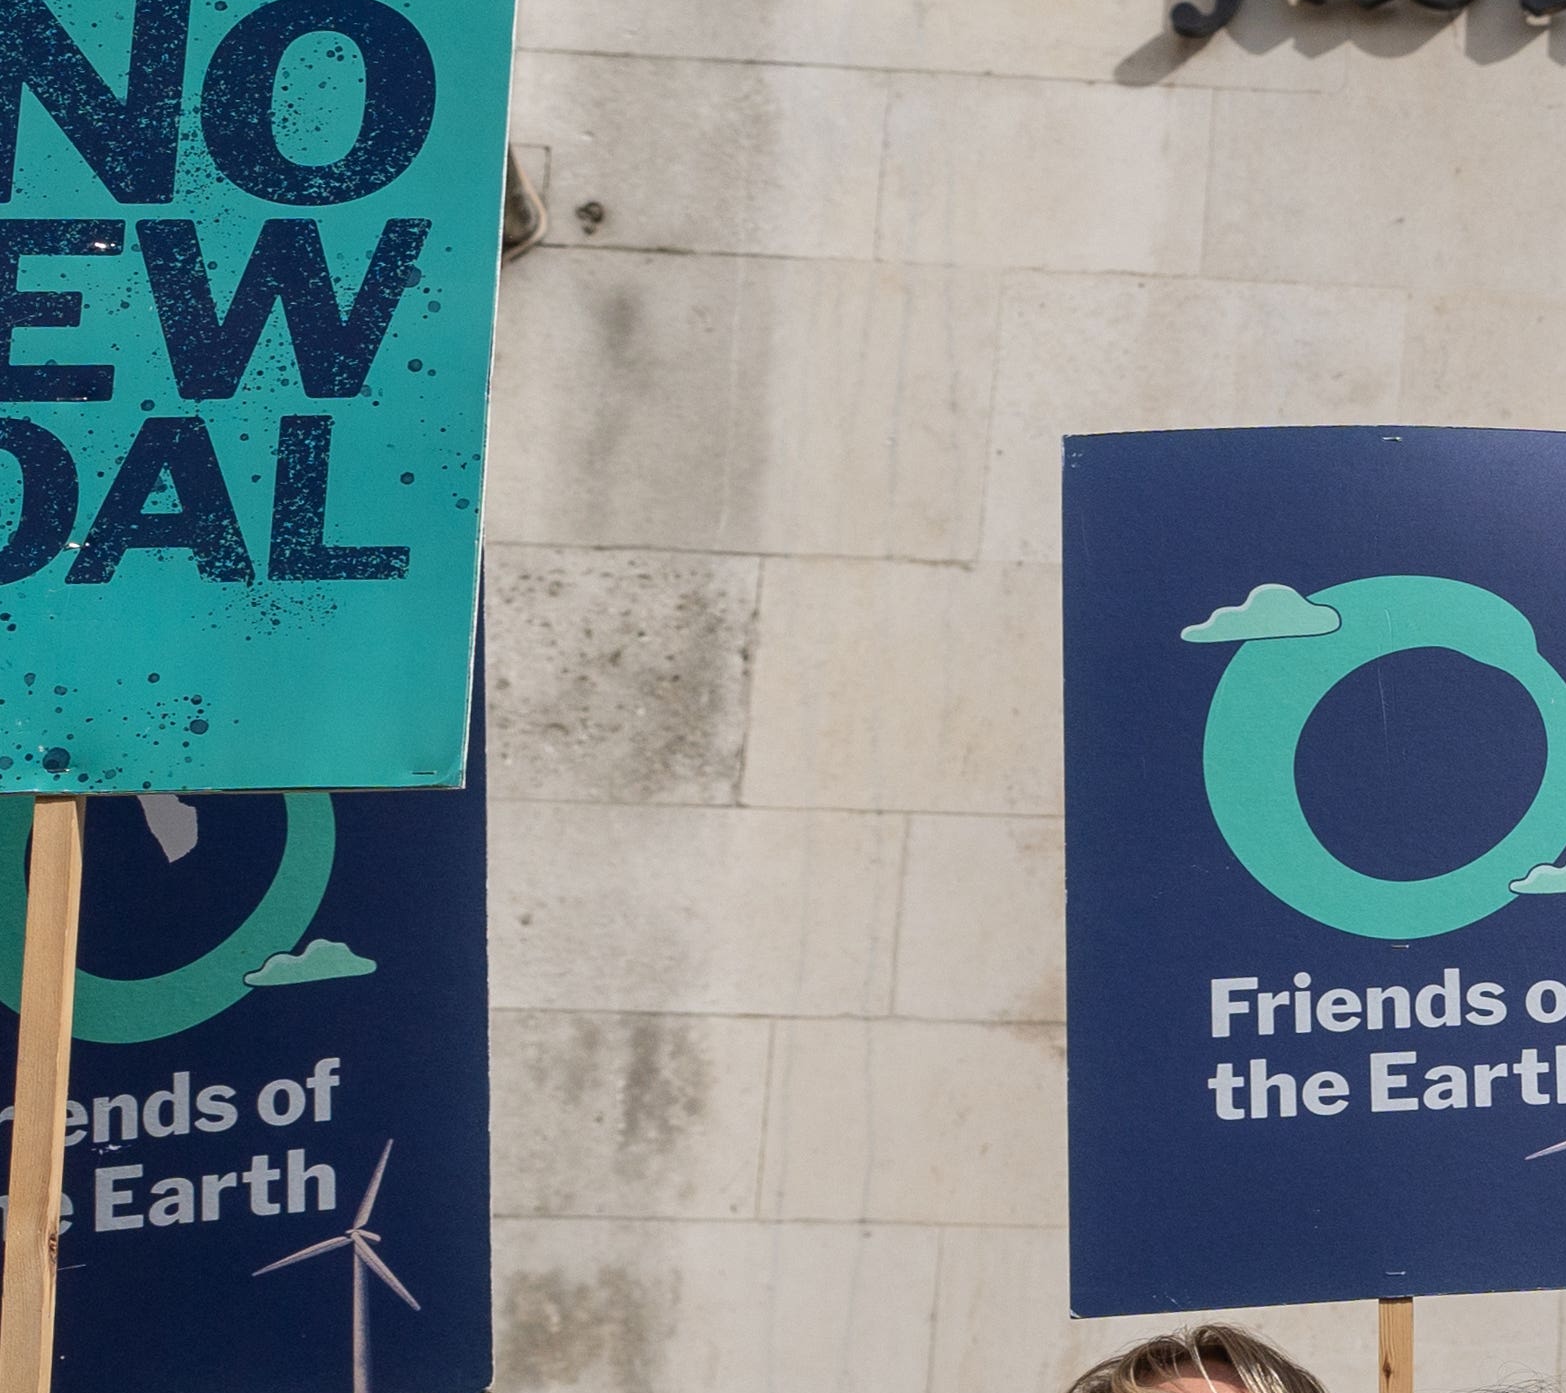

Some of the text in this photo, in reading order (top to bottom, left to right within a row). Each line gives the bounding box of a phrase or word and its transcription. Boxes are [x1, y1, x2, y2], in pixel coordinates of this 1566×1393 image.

[1210, 967, 1507, 1039] Friends
[257, 1057, 341, 1127] of
[1207, 1058, 1350, 1122] the
[94, 1148, 336, 1232] Earth
